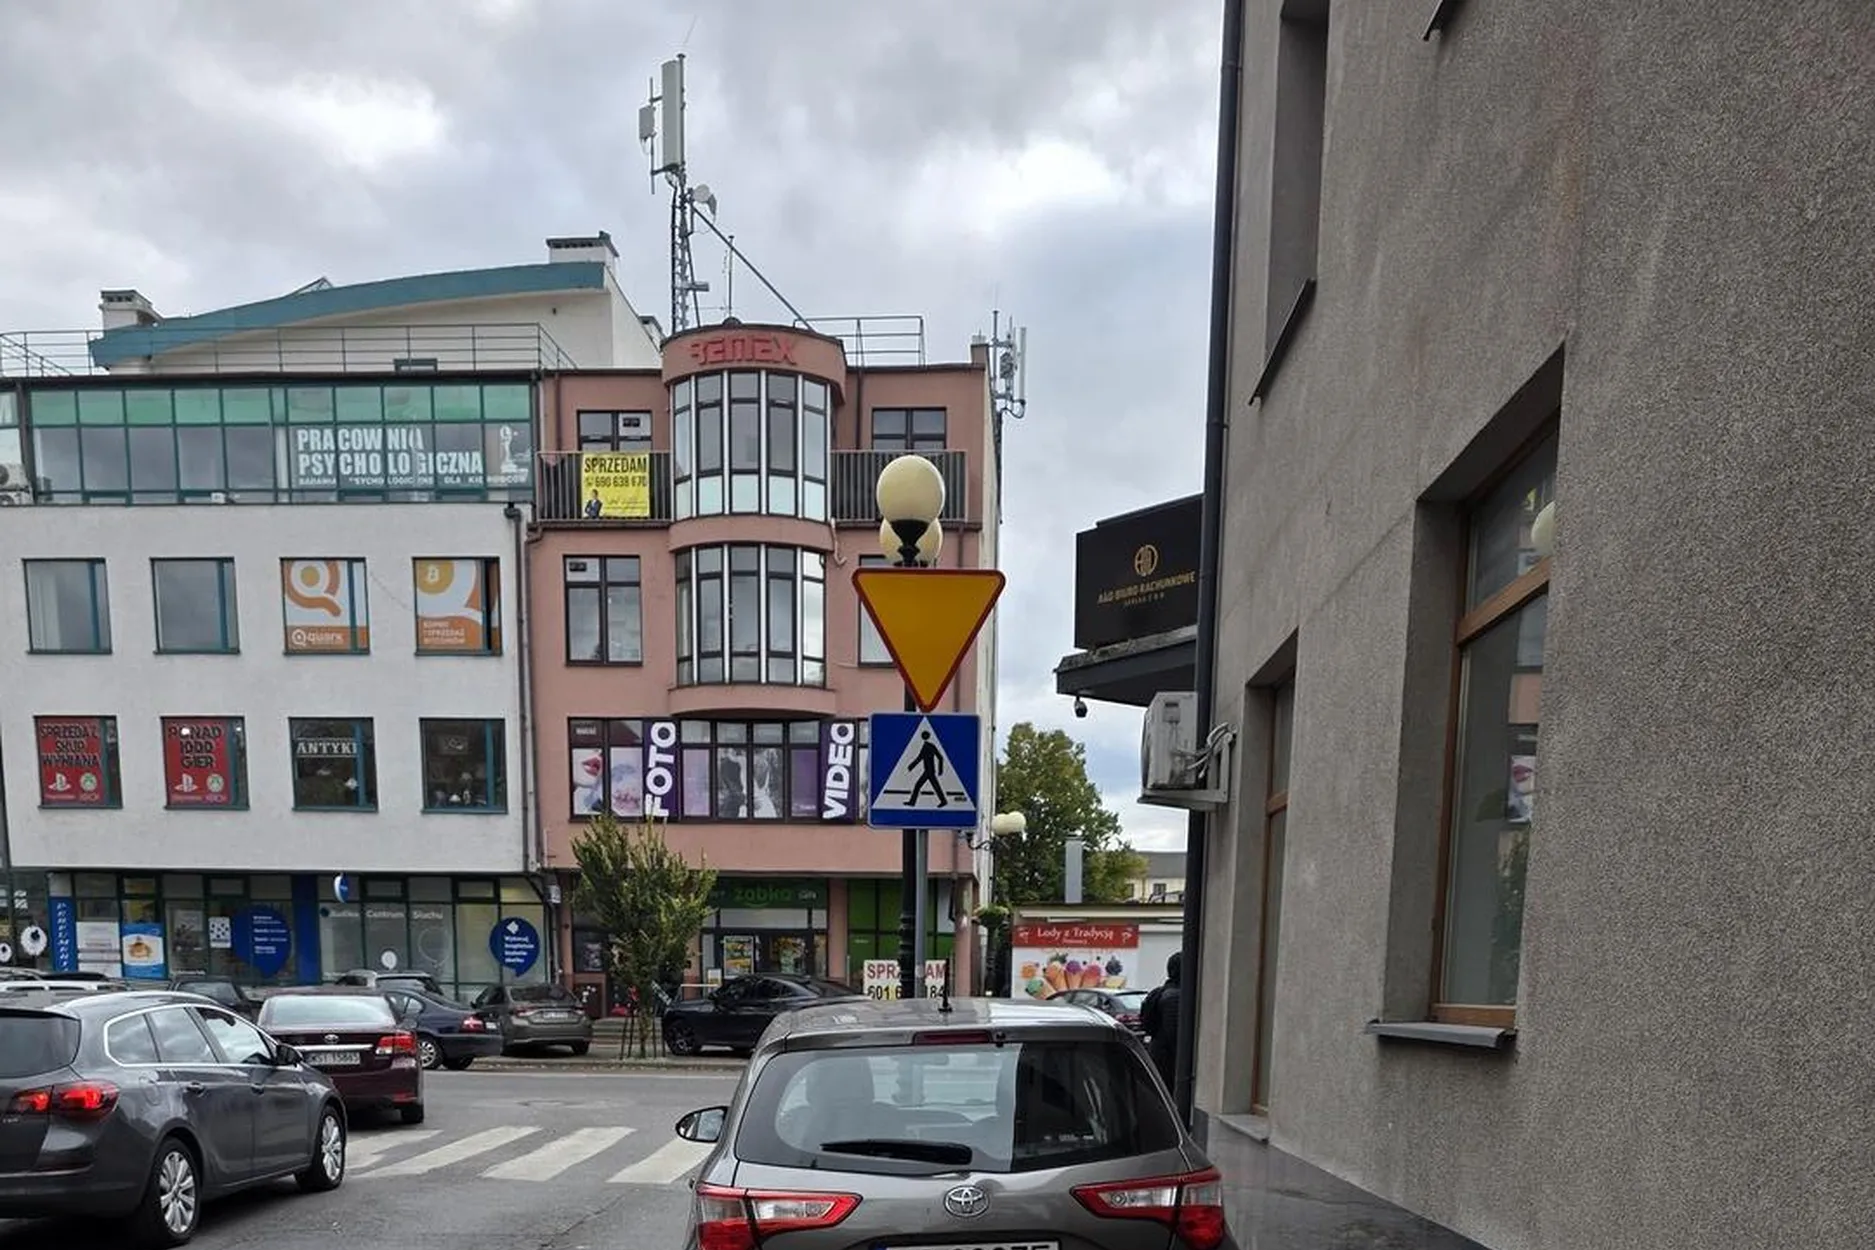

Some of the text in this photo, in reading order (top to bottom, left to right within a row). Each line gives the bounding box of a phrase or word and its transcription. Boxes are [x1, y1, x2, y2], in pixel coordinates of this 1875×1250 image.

[297, 428, 423, 450] PRACOWNIA
[299, 452, 484, 475] PSYCHOLOGICZNA
[584, 457, 647, 473] SPRZEDAM
[297, 742, 357, 754] ANTYKI
[646, 722, 677, 817] FOTO
[822, 723, 854, 819] VIDEO
[1037, 927, 1060, 939] Lody
[867, 963, 946, 979] SPRAM
